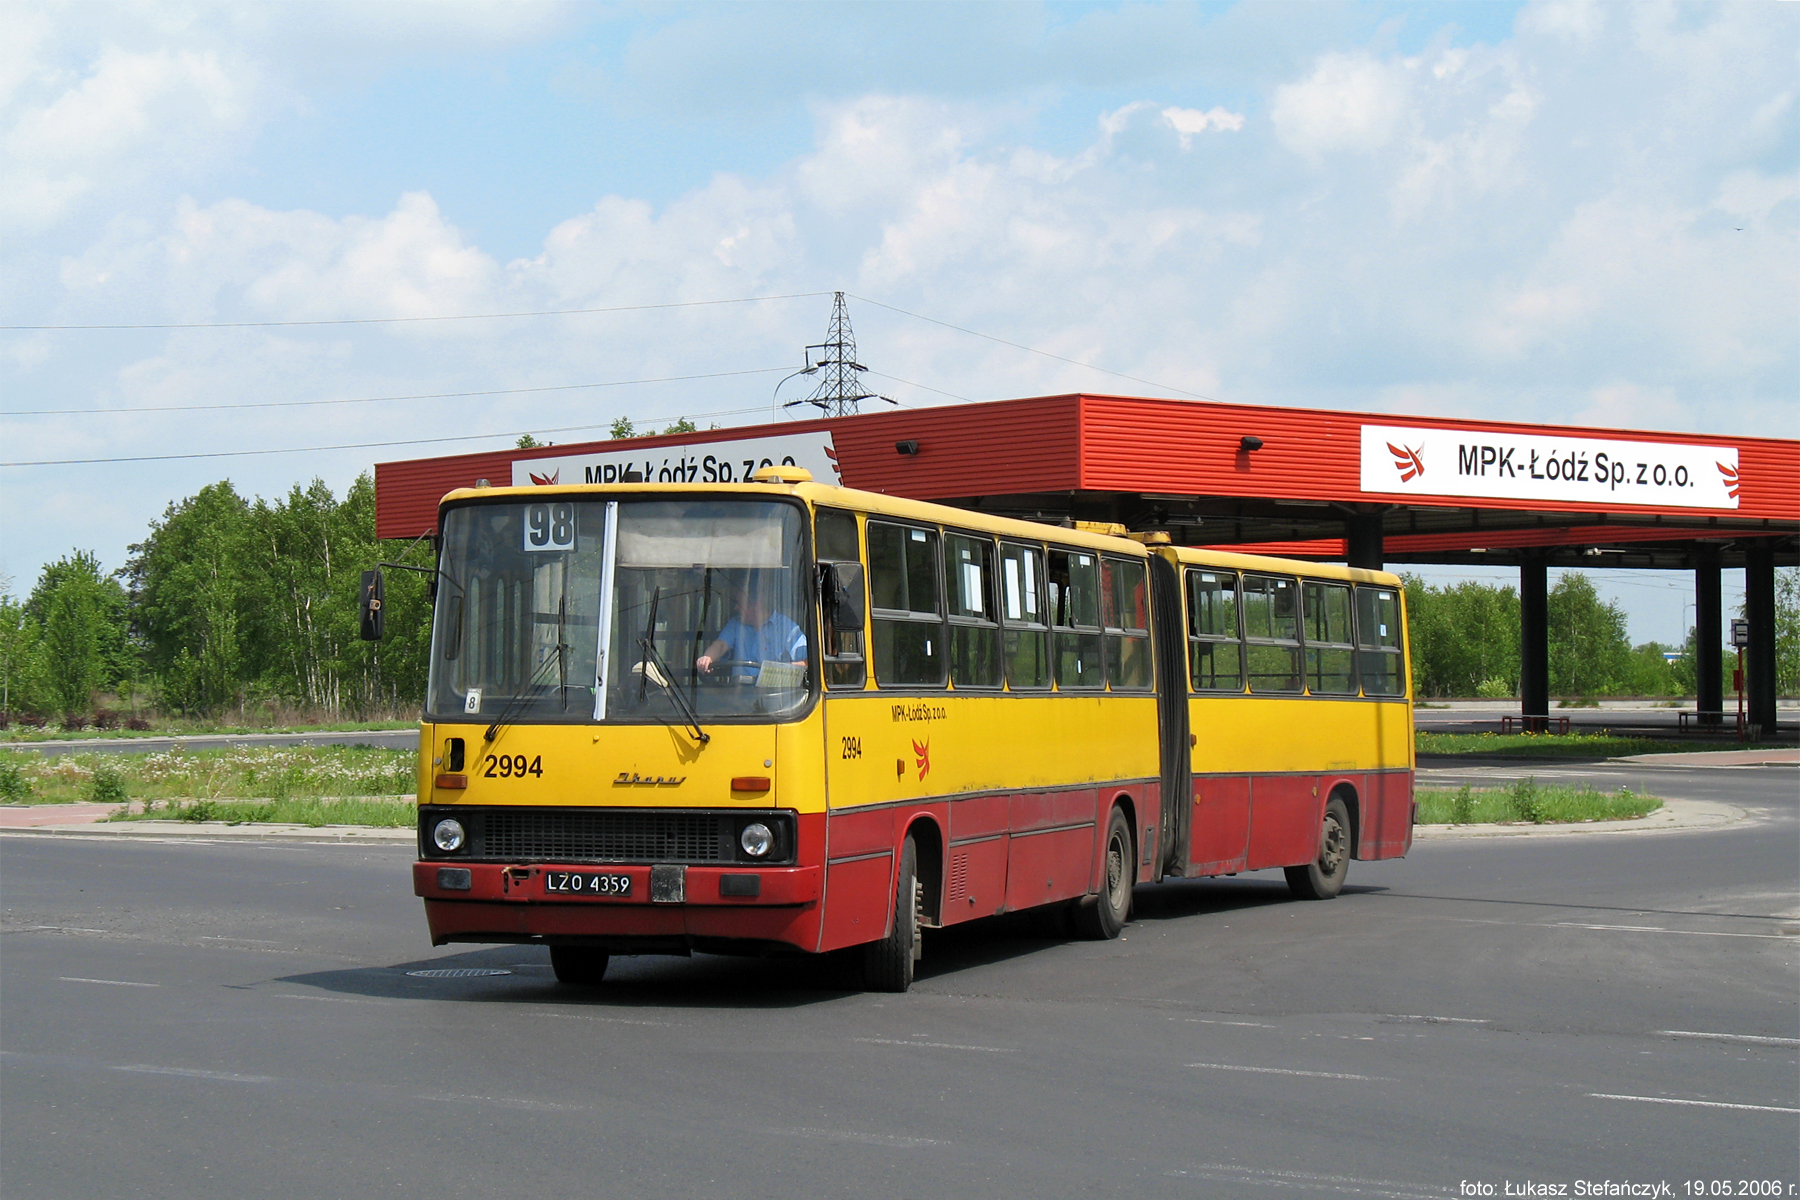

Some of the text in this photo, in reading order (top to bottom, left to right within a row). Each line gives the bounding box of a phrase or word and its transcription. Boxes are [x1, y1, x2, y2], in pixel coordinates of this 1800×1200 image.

[585, 456, 698, 483] MPKŁódź
[702, 455, 738, 483] Sp.
[743, 460, 755, 483] z
[1458, 444, 1694, 491] MPK-Łódź Sp. z o.o.
[529, 502, 573, 546] 98
[468, 696, 476, 710] 8
[891, 703, 923, 722] MPK-Łódź
[932, 707, 937, 720] z
[841, 735, 862, 760] 2994
[484, 754, 543, 779] 2994
[613, 772, 687, 785] Ikarus
[548, 874, 630, 893] LZO 4359
